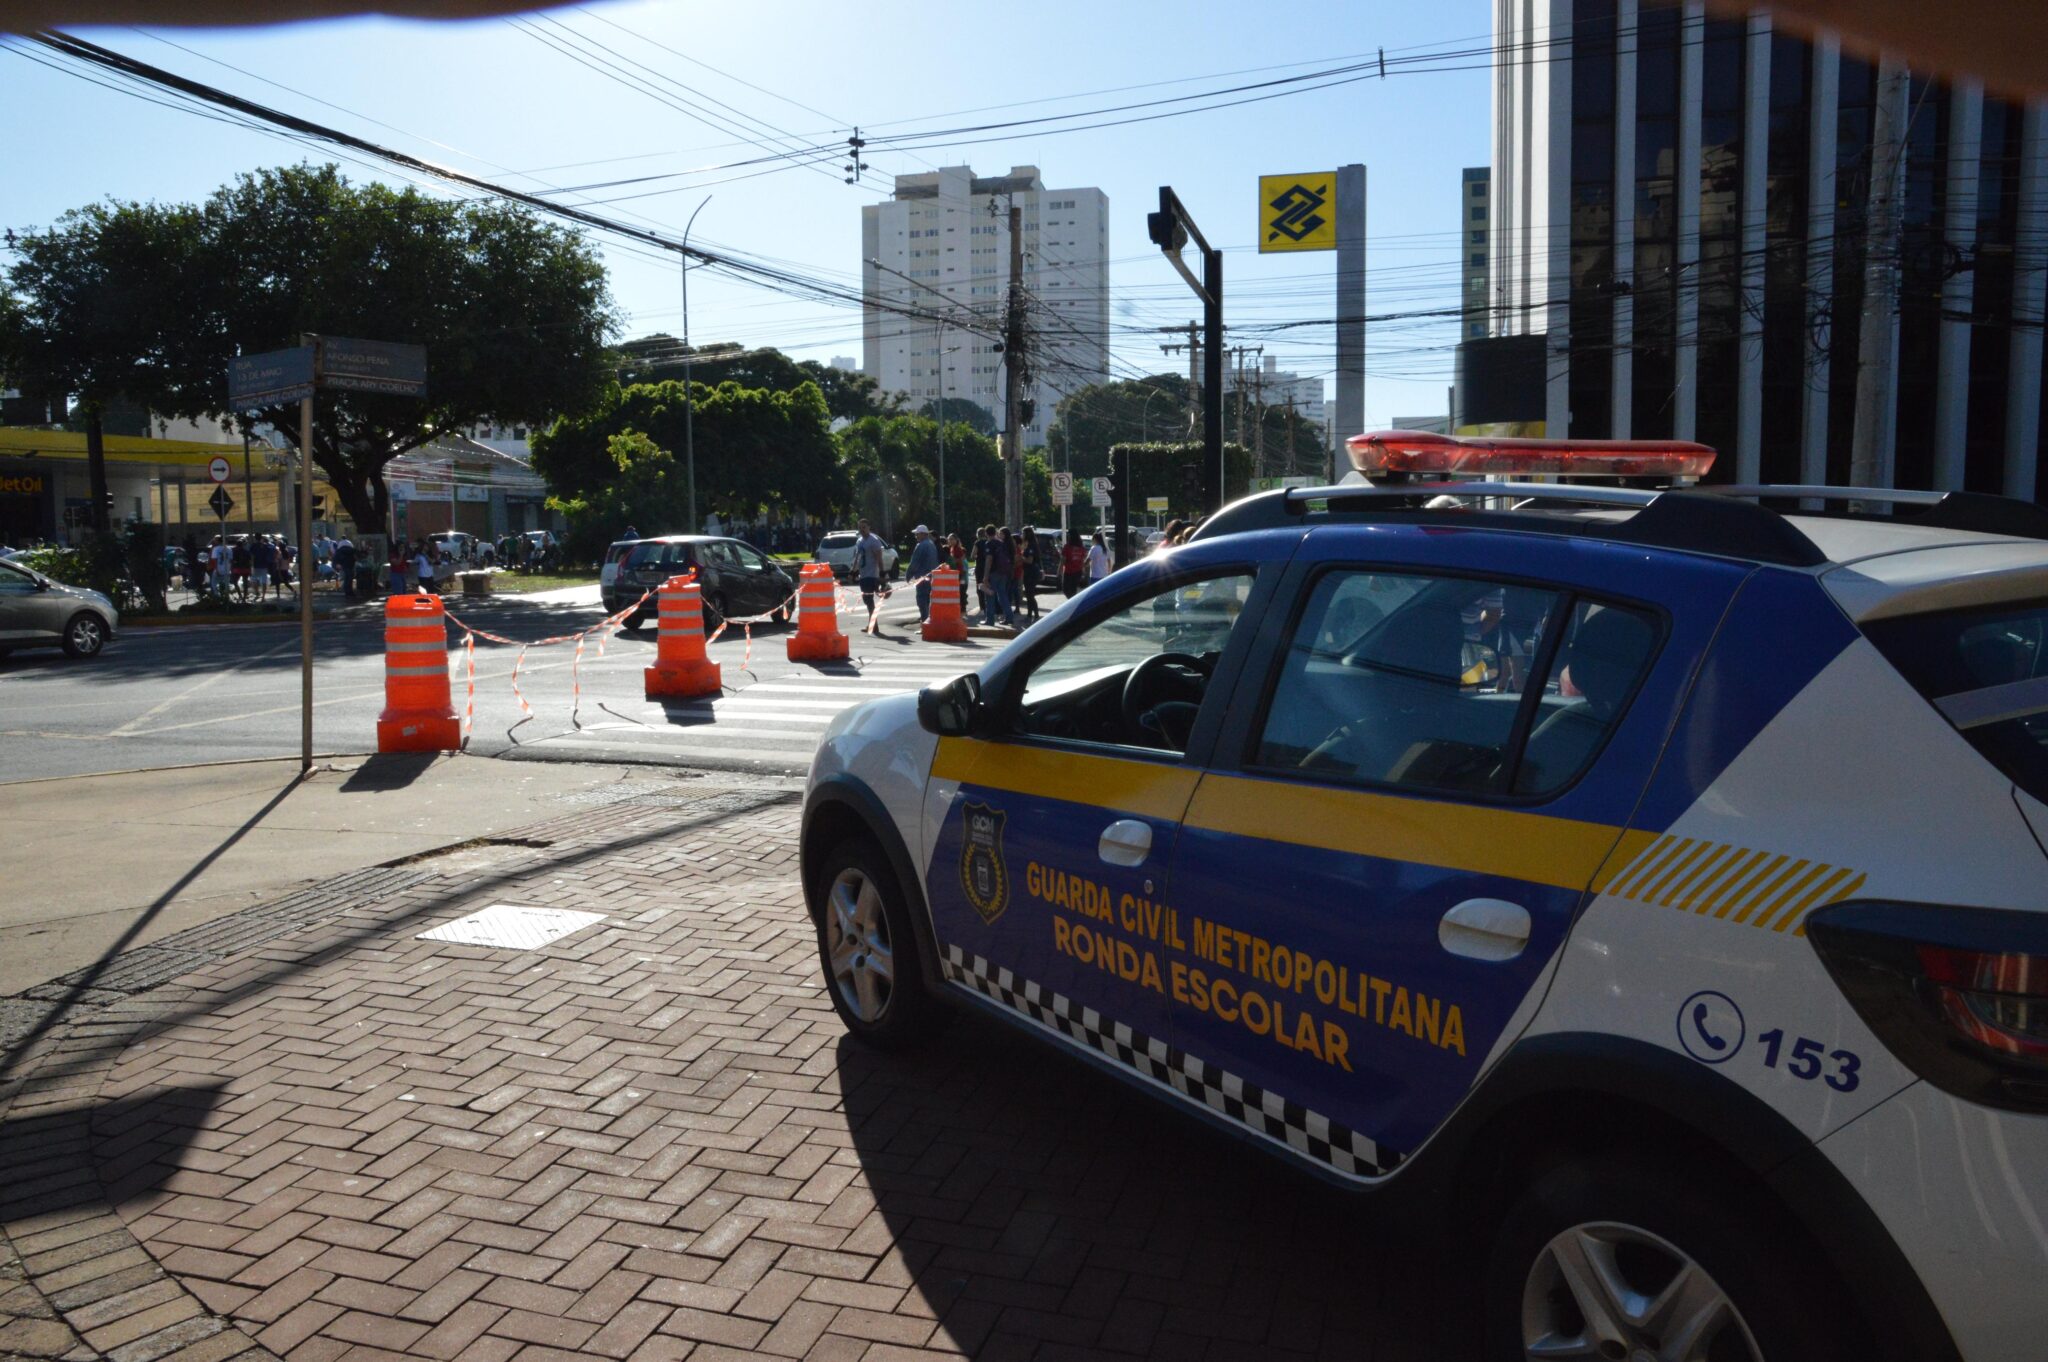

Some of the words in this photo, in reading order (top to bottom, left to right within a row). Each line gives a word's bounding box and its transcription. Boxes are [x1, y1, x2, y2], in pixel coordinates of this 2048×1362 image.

[235, 361, 252, 370] RUA
[326, 352, 365, 363] AFONSO
[367, 356, 390, 366] PENA
[327, 376, 358, 389] PRAÇA
[379, 382, 418, 394] COELHO
[972, 814, 994, 832] GCM
[1026, 861, 1114, 925] GUARDA
[1120, 893, 1185, 951] CIVIL
[1194, 917, 1466, 1057] METROPOLITANA
[1054, 915, 1164, 994] RONDA
[1171, 960, 1354, 1072] ESCOLAR
[1758, 1028, 1861, 1092] 153
